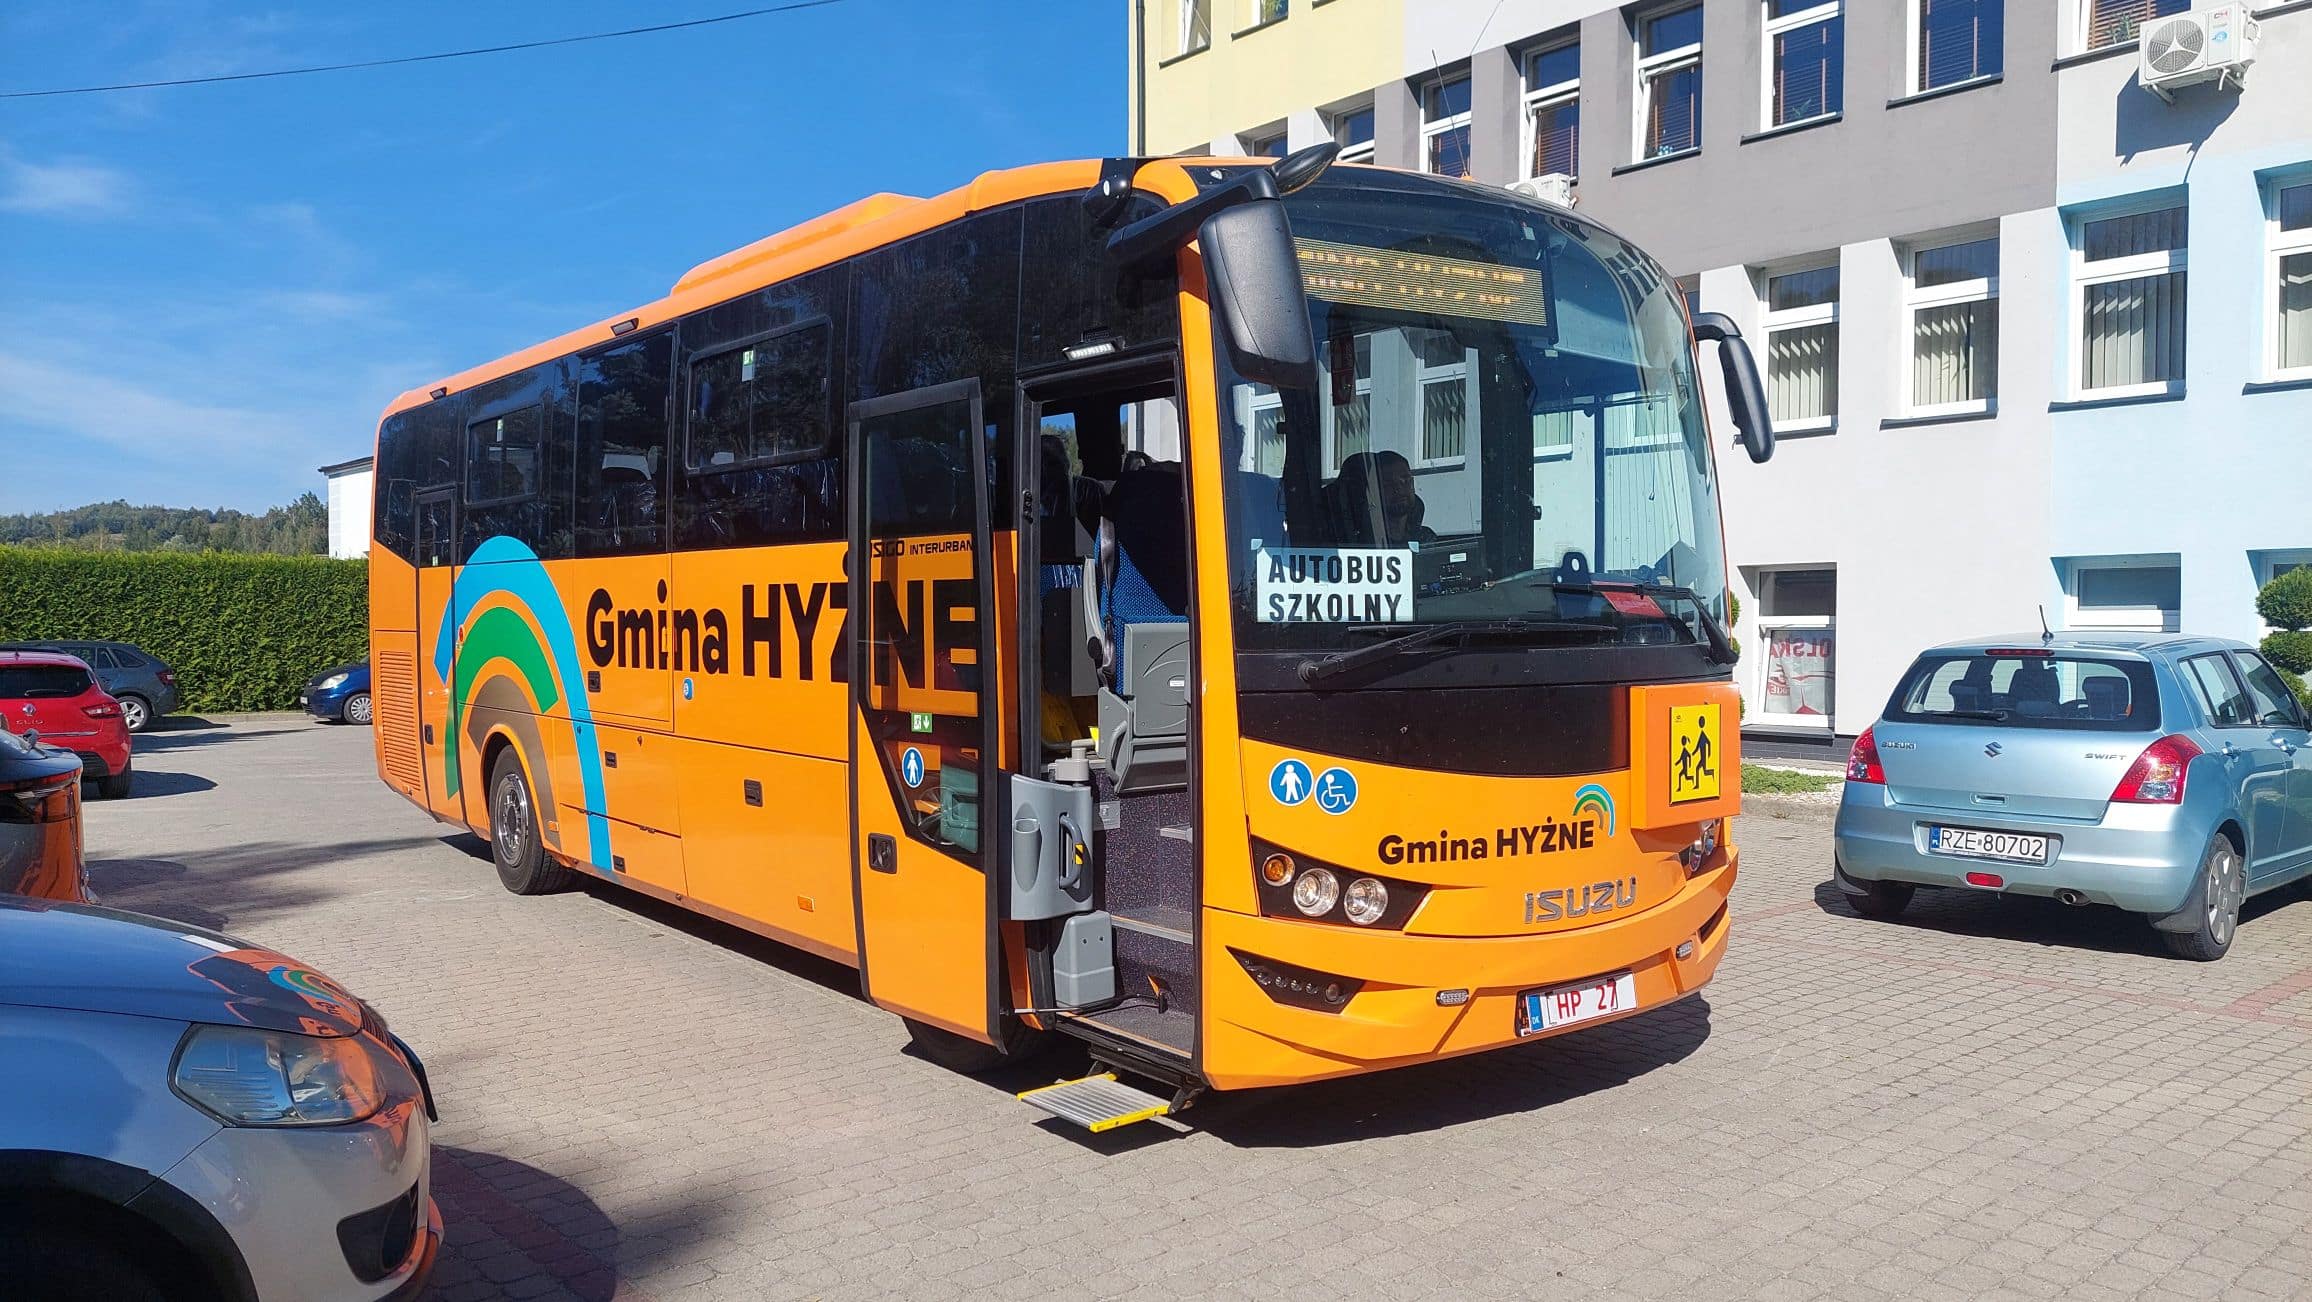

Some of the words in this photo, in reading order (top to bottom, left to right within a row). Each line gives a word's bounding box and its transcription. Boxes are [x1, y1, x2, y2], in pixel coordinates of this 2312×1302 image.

[1268, 555, 1402, 584] AUTOBUS
[1268, 593, 1403, 622] SZKOLNY
[586, 578, 729, 676] Gmina
[1881, 741, 1917, 750] SUZUKI
[2084, 752, 2128, 761] SWIFT
[1378, 830, 1488, 864] Gmina
[1496, 815, 1595, 857] HYŻNE
[1940, 829, 1978, 851] RZE
[1983, 833, 2044, 858] 80702
[1524, 876, 1637, 924] ISUZU
[1556, 990, 1583, 1020] HP
[1595, 980, 1617, 1011] 27
